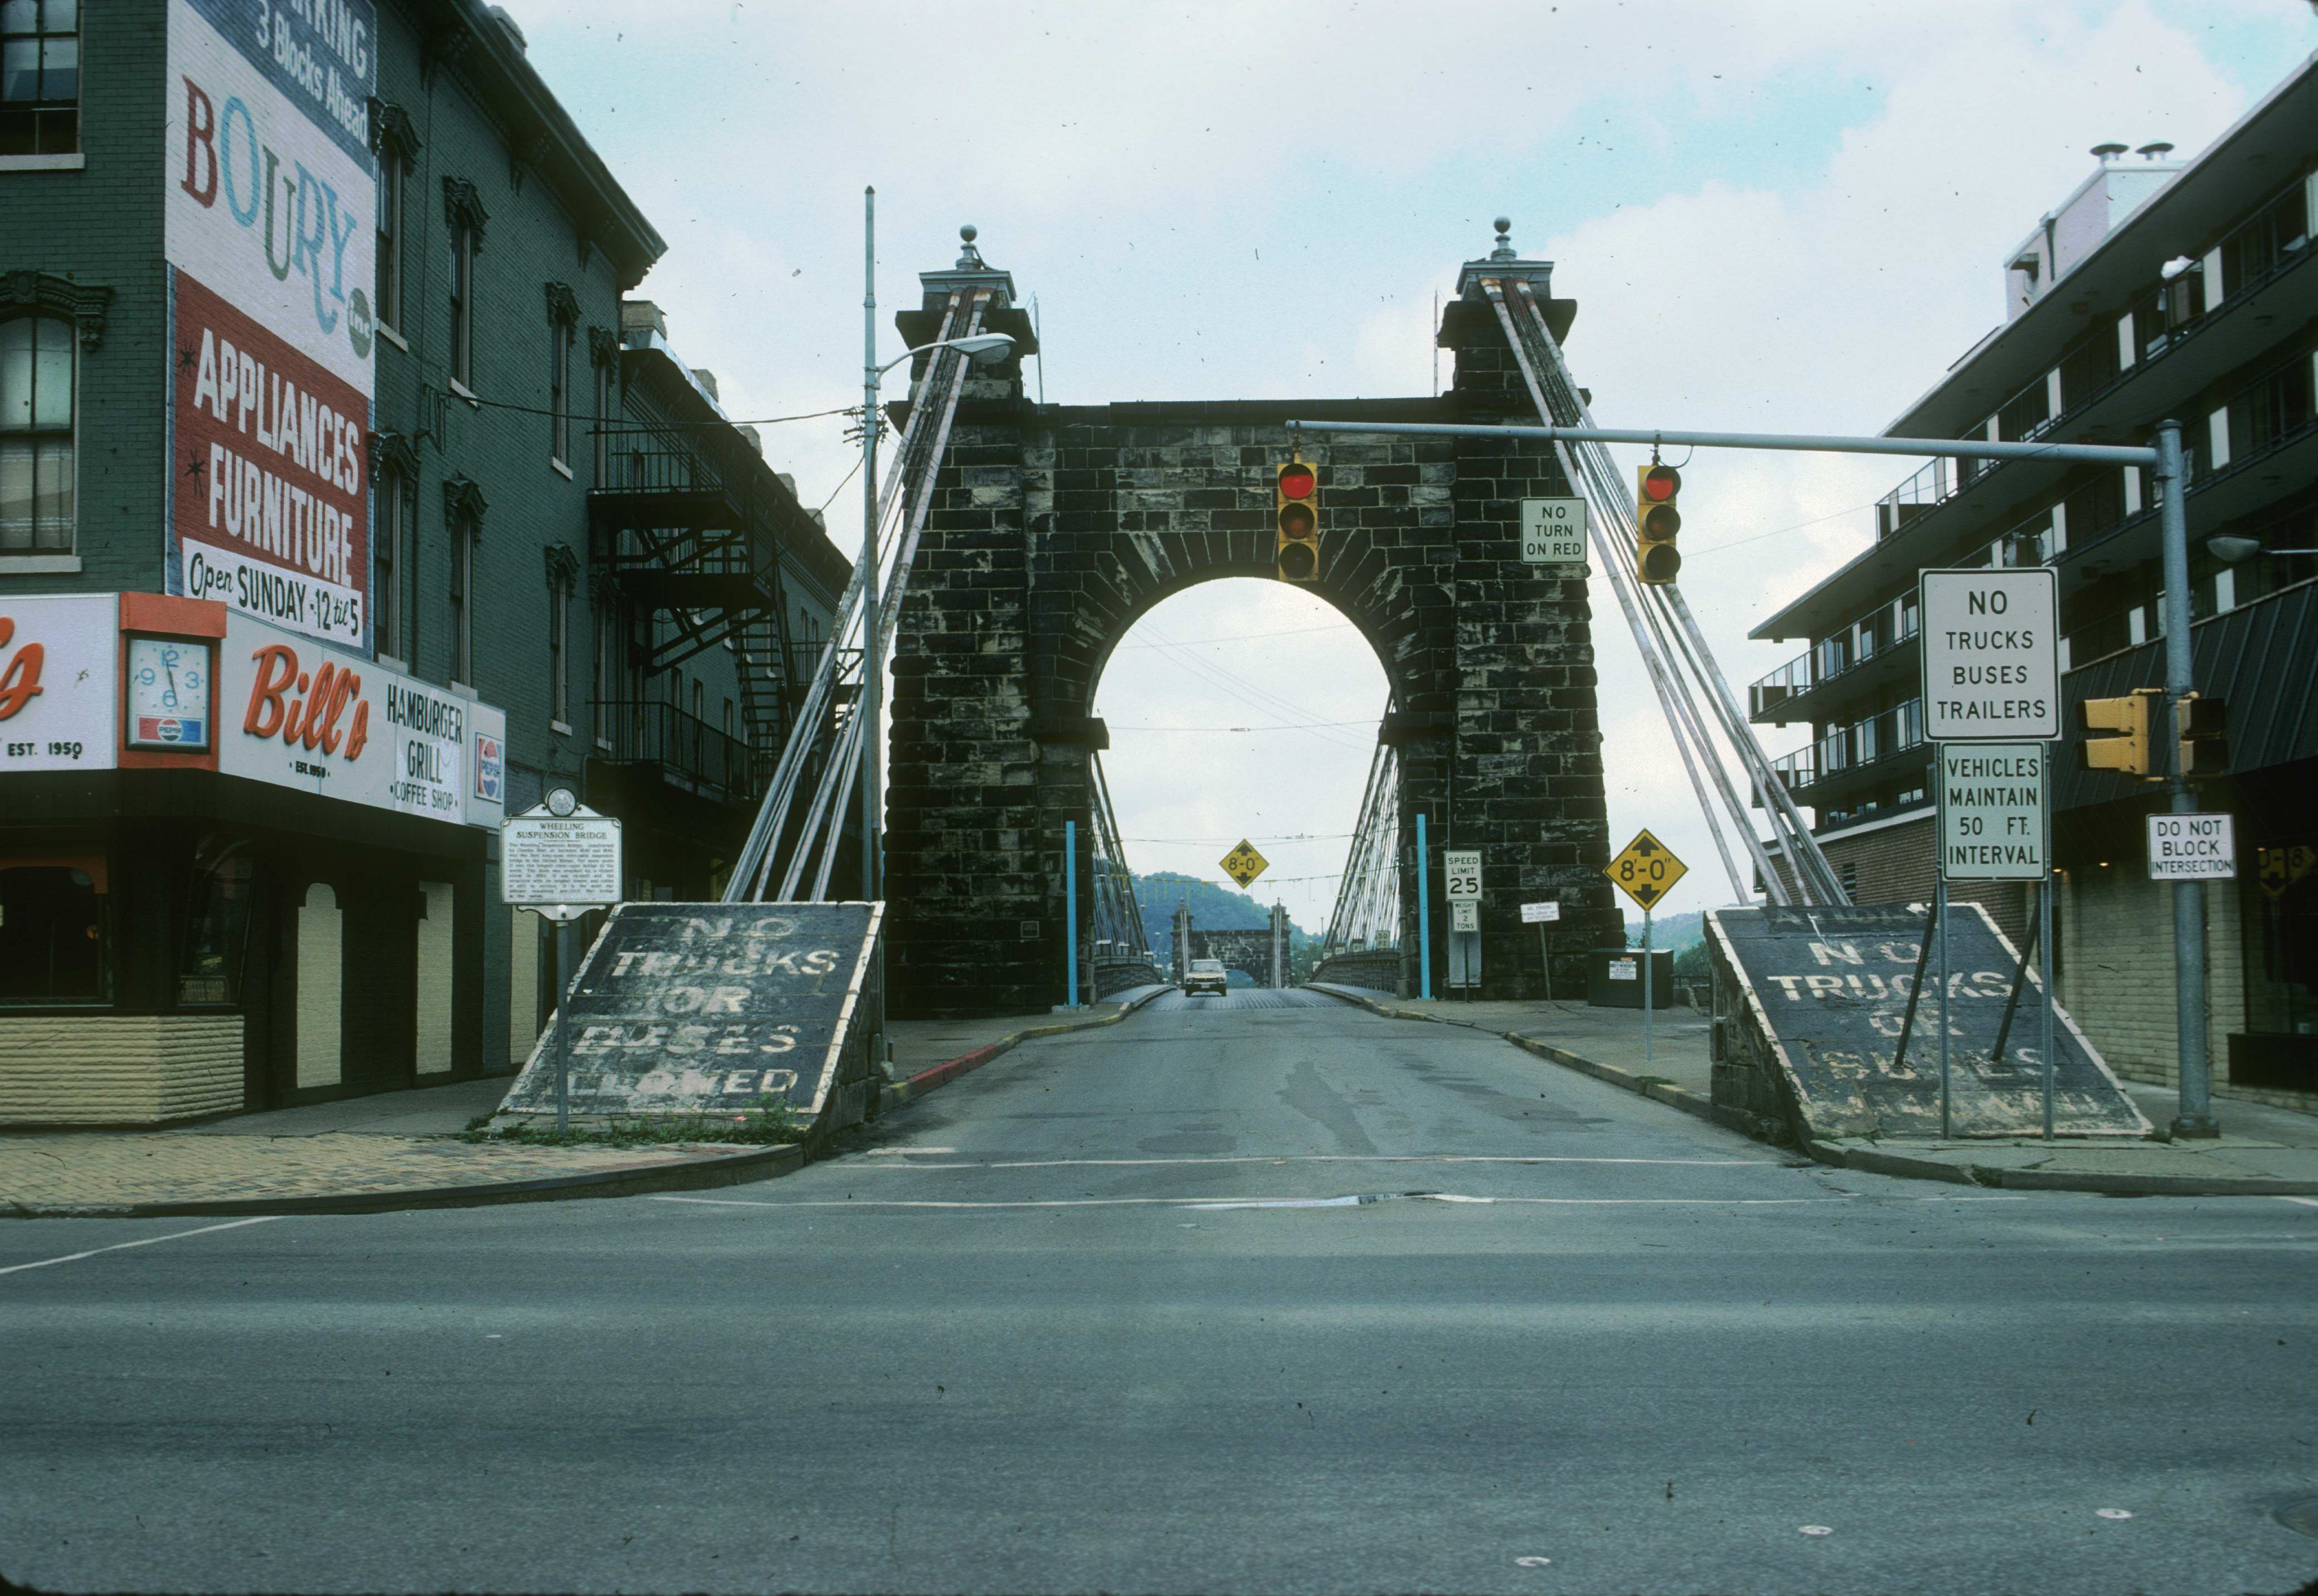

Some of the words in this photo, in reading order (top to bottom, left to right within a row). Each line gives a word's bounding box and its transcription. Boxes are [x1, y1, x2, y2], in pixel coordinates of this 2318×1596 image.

[255, 0, 270, 48] 3
[275, 10, 323, 102] Blocks
[326, 66, 368, 147] Ahead
[181, 74, 357, 333] BOURY
[193, 328, 359, 496] APPLIANCES
[209, 443, 352, 588] FURNITURE
[1543, 507, 1566, 518] NO
[1536, 525, 1573, 537] TURN
[1527, 543, 1546, 555] ON
[1553, 543, 1581, 555] RED
[190, 552, 234, 599] Open
[238, 565, 306, 622] SUNDAY
[334, 597, 348, 626] til
[351, 598, 358, 636] 5
[1968, 591, 2008, 615] NO
[1946, 631, 2034, 650] TRUCKS
[161, 649, 179, 668] 12
[140, 668, 154, 686] 9
[185, 671, 199, 689] 3
[1953, 666, 2028, 685] BUSES
[163, 690, 178, 708] 6
[243, 644, 369, 761] Bill's
[387, 684, 462, 744] HAMBURGER
[1938, 700, 2046, 720] TRAILERS
[8, 743, 38, 756] EST.
[48, 742, 82, 756] 1950
[408, 740, 442, 784] GRILL
[1948, 758, 2039, 778] VEHICLES
[395, 780, 427, 806] COFFEE
[432, 789, 453, 811] SHOP
[1949, 787, 2037, 807] MAINTAIN
[1960, 817, 1983, 836] 50
[2007, 816, 2030, 836] FT.
[2157, 821, 2180, 836] DO
[2190, 820, 2222, 835] NOT
[1950, 845, 2040, 865] INTERVAL
[2162, 840, 2220, 856] BLOCK
[2152, 860, 2233, 873] INTERSECTION
[1450, 877, 1479, 894] 25
[679, 917, 796, 937] NO
[1807, 941, 1924, 965] NO
[611, 950, 840, 977] TRUCKS
[1767, 971, 2014, 1001] TRUCKS
[664, 986, 751, 1013] OR
[572, 1025, 802, 1055] BUSES
